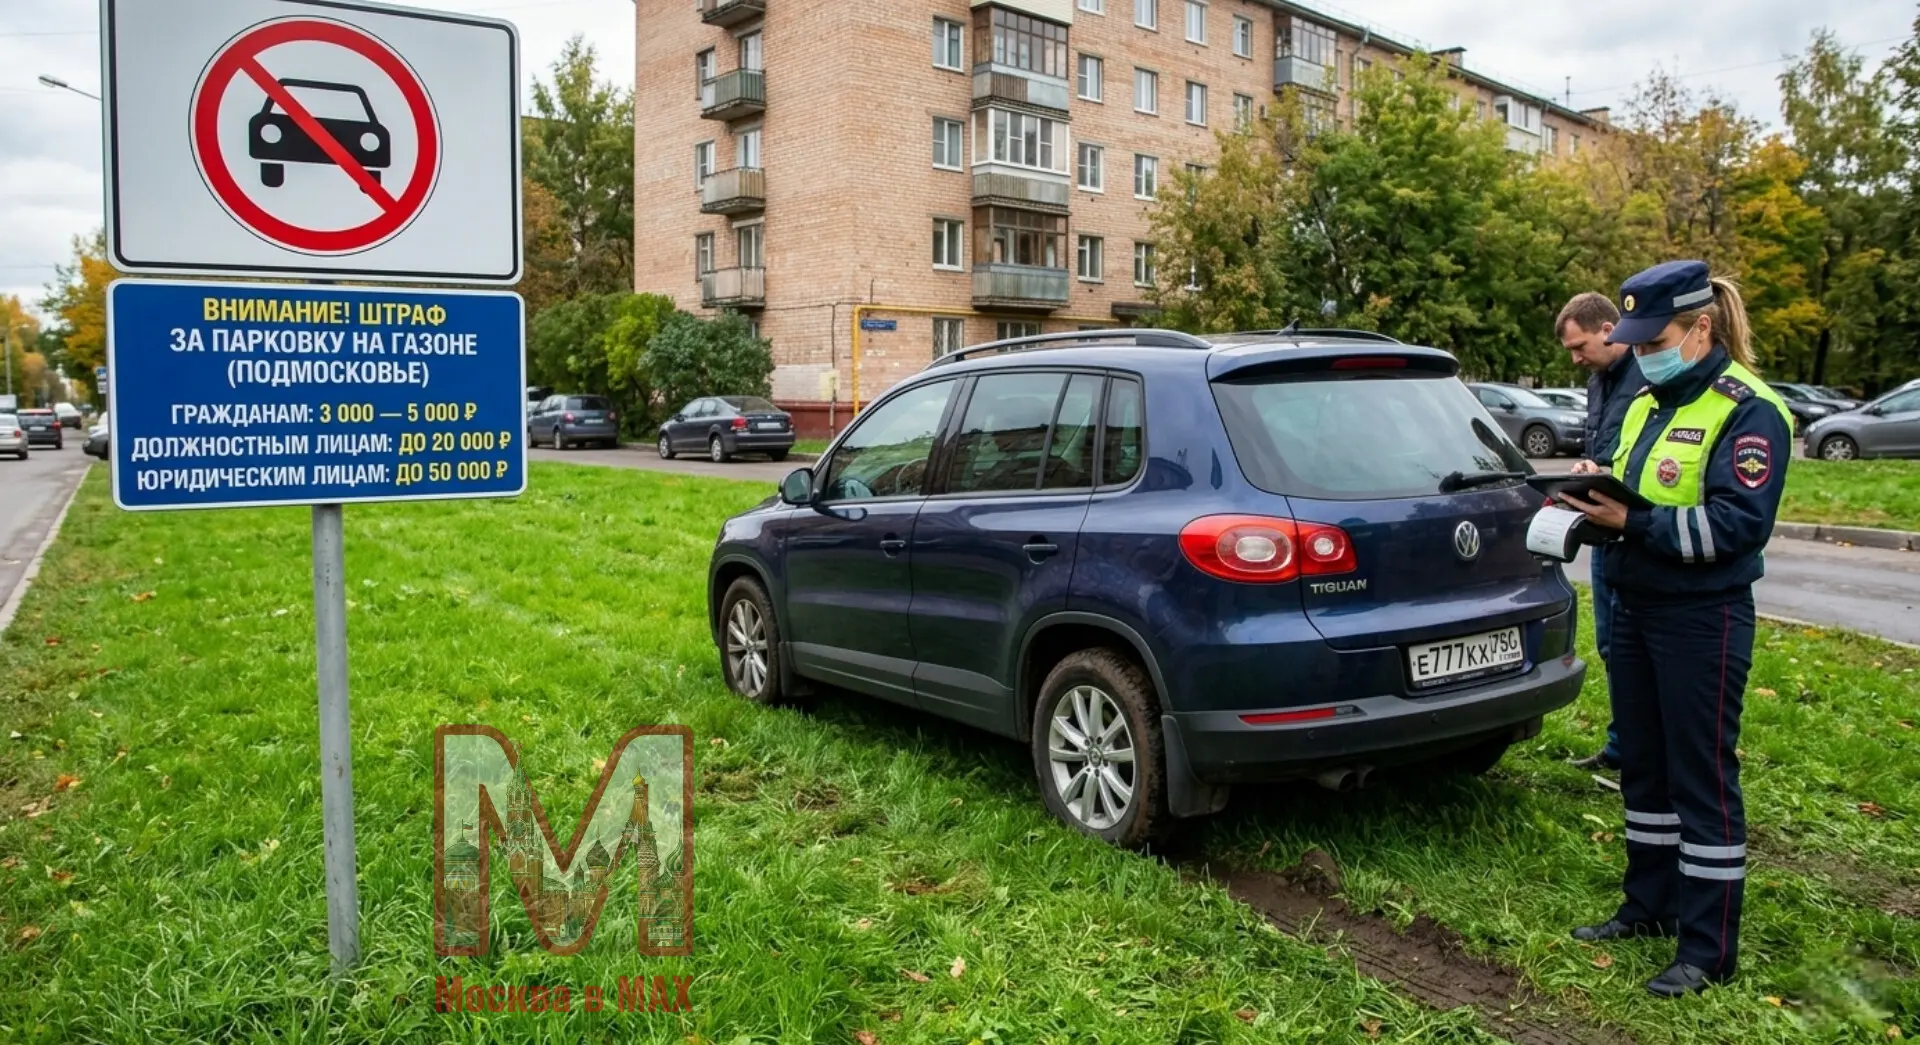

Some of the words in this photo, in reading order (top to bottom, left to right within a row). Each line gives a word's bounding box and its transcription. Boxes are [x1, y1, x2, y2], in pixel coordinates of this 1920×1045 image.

[203, 297, 350, 324] ВНИМАНИЕ!
[359, 302, 447, 326] ШТРАФ
[170, 327, 205, 352] ЗА
[212, 328, 345, 353] ПАРКОВКУ
[352, 331, 385, 354] НА
[392, 332, 477, 355] ГАЗОНЕ
[227, 359, 429, 389] (ПОДМОСКОВЬЕ)
[172, 403, 314, 428] ГРАЖДАНАМ:
[319, 403, 332, 423] 3
[337, 403, 374, 423] 000
[407, 403, 419, 422] 5
[424, 402, 459, 422] 000
[131, 435, 309, 462] ДОЛЖНОСТНЫМ
[315, 433, 393, 456] ЛИЦАМ:
[398, 432, 426, 456] ДО
[431, 432, 455, 451] 20
[460, 431, 494, 451] 000
[137, 466, 305, 493] ЮРИДИЧЕСКИМ
[312, 463, 390, 487] ЛИЦАМ:
[395, 462, 423, 486] ДО
[429, 462, 452, 482] 50
[457, 461, 491, 481] 000
[1310, 579, 1367, 594] TIGUAN
